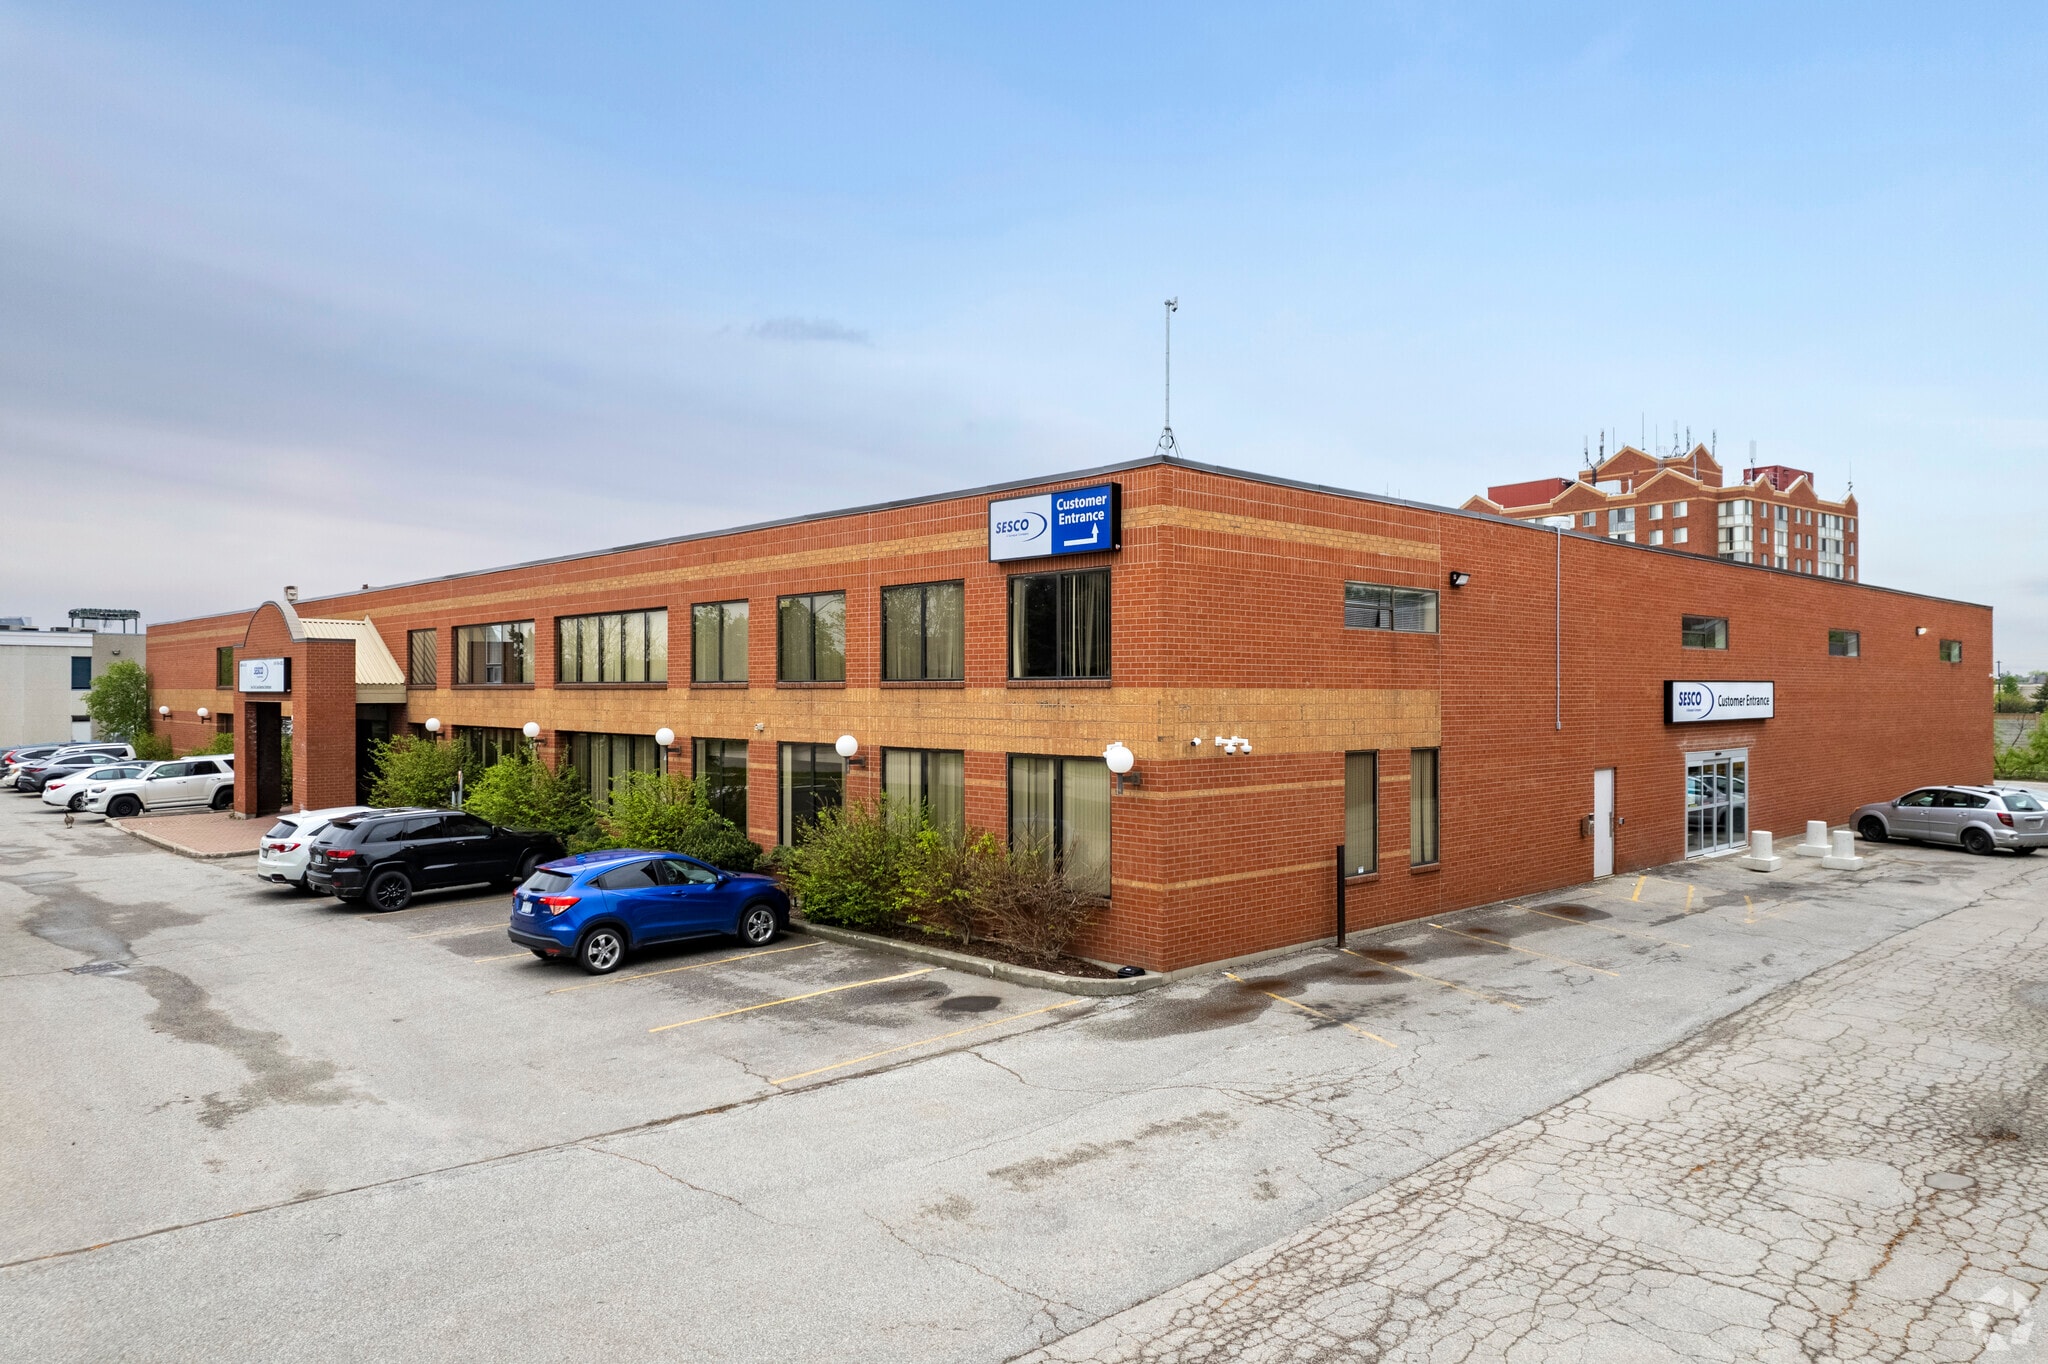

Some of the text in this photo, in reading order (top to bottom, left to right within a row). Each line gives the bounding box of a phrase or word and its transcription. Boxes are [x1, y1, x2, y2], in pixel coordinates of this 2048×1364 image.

[1056, 495, 1107, 511] Customer
[1058, 510, 1105, 525] Entrance
[995, 518, 1029, 534] SESCO
[1678, 691, 1770, 707] SESCO Customer Entrance
